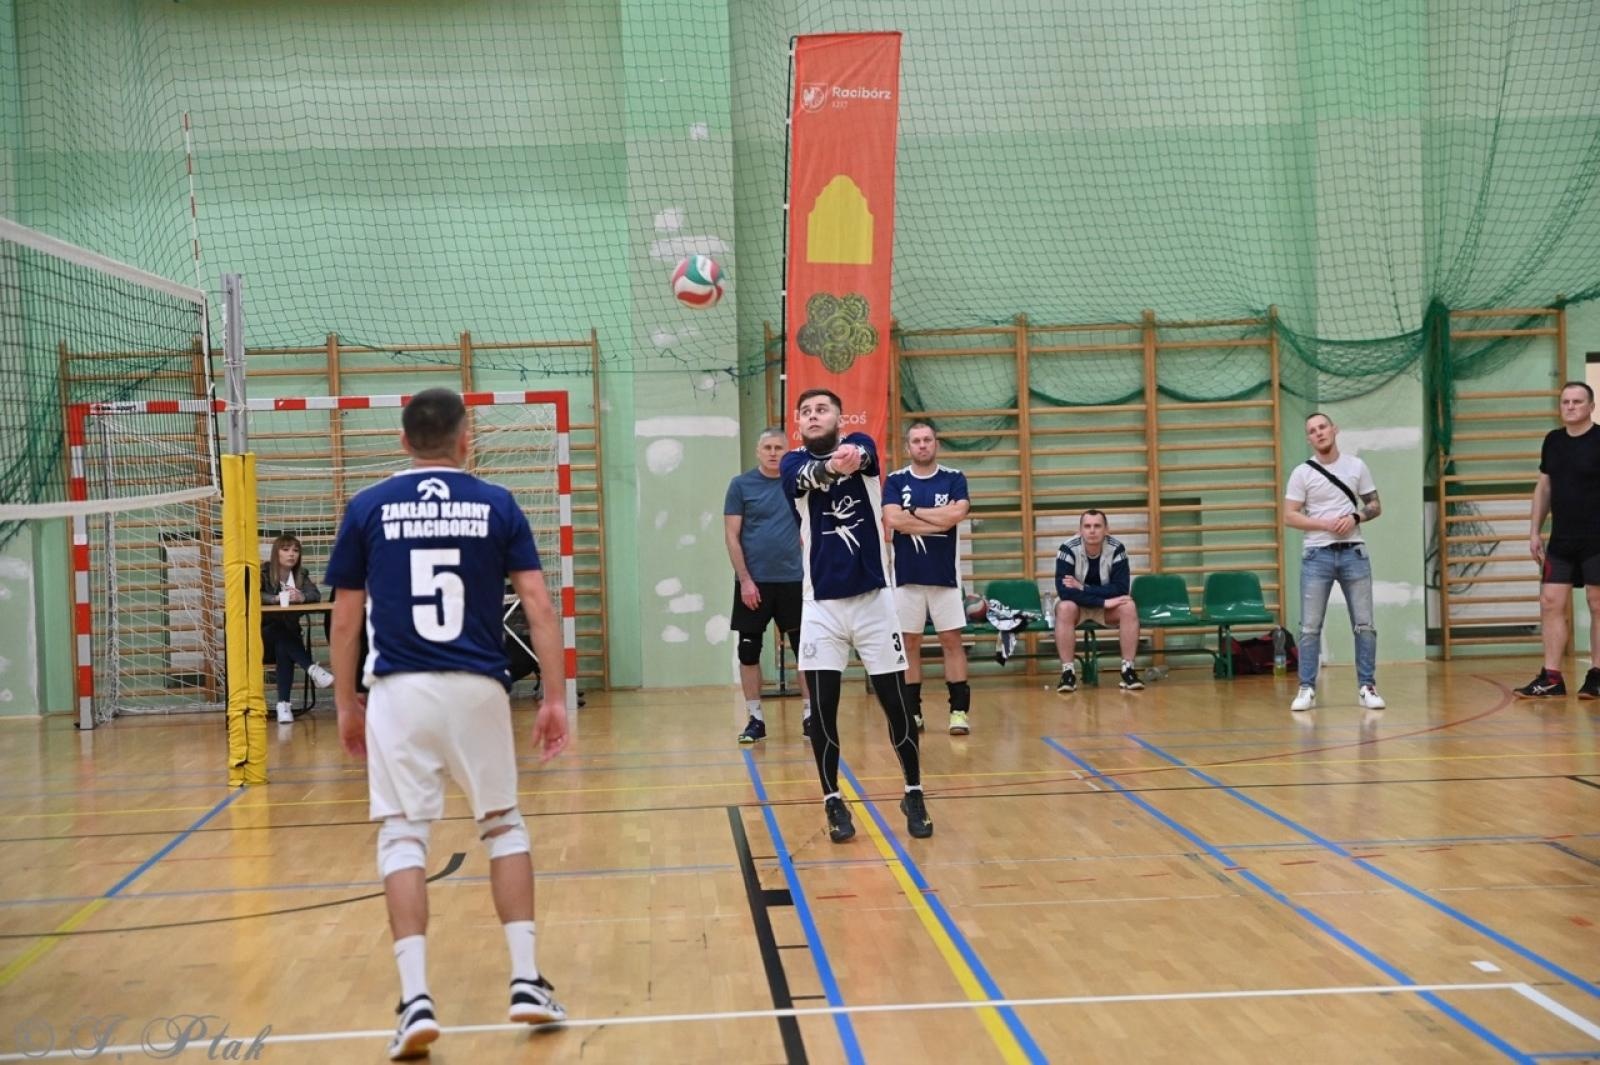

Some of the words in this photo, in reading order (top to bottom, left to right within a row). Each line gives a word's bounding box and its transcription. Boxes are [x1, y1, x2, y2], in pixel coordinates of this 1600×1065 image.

[832, 86, 892, 100] Racibórz
[902, 493, 912, 507] 2
[381, 502, 439, 521] ZAKŁAD
[440, 503, 491, 520] KARNY
[384, 522, 401, 540] W
[402, 520, 489, 539] RACIBORZU
[410, 549, 466, 642] 5
[892, 632, 902, 652] 3
